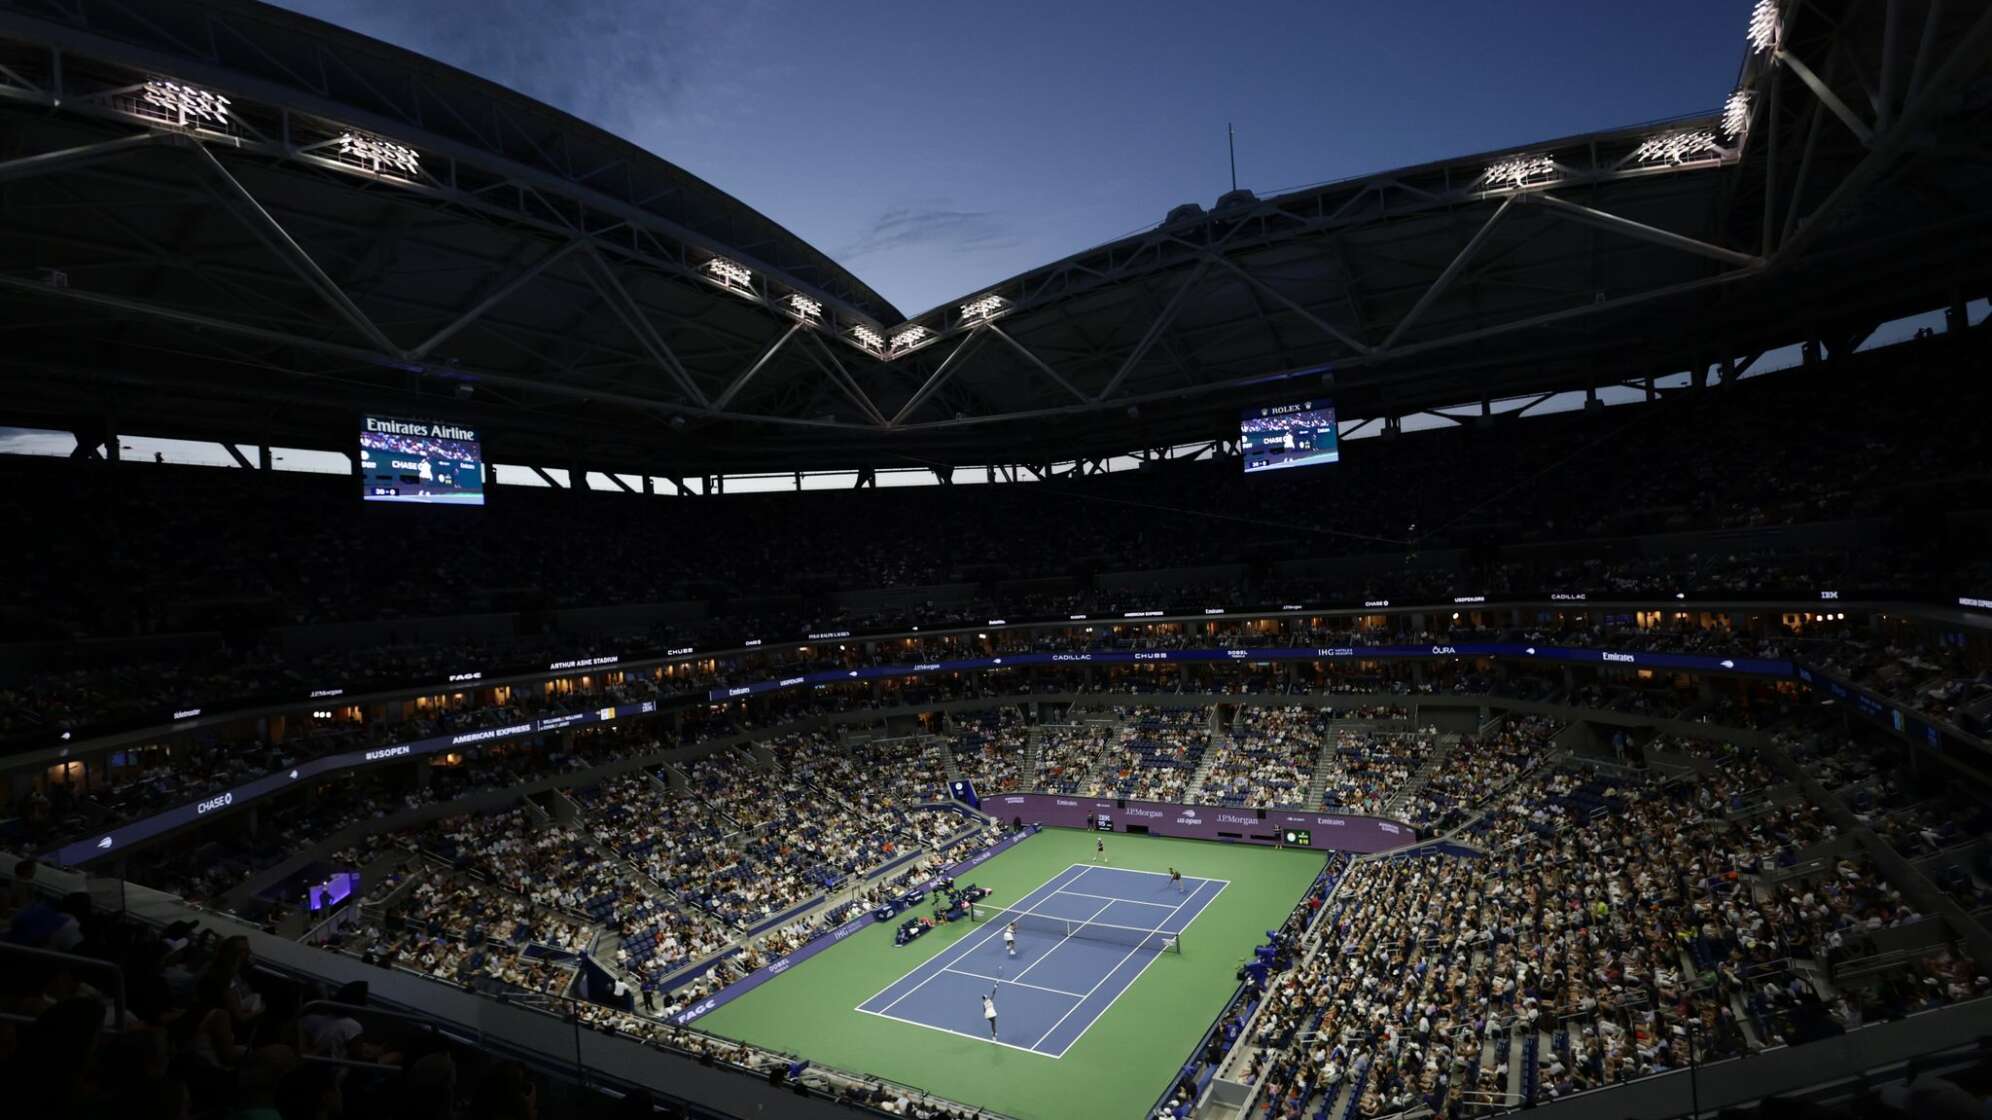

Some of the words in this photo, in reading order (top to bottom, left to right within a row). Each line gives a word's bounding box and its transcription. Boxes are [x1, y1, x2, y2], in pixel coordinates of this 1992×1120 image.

[1272, 404, 1301, 415] ROLEX
[366, 417, 428, 436] Emirates
[430, 424, 475, 441] Airline
[391, 460, 418, 470] CHASE
[1821, 591, 1838, 599] IBM
[550, 660, 576, 670] ARTHUR
[576, 658, 593, 667] ASHE
[593, 656, 618, 666] STADIUM
[1602, 652, 1635, 663] Emirates
[449, 672, 482, 682] FAGE
[452, 730, 495, 745] AMERICAN
[496, 724, 531, 737] EXPRESS
[197, 795, 225, 814] CHASE
[1126, 808, 1163, 818] J.P.Morgan
[1216, 814, 1259, 825] J.P.Morgan
[1318, 818, 1345, 826] Emirates
[678, 999, 716, 1023] FAGE
